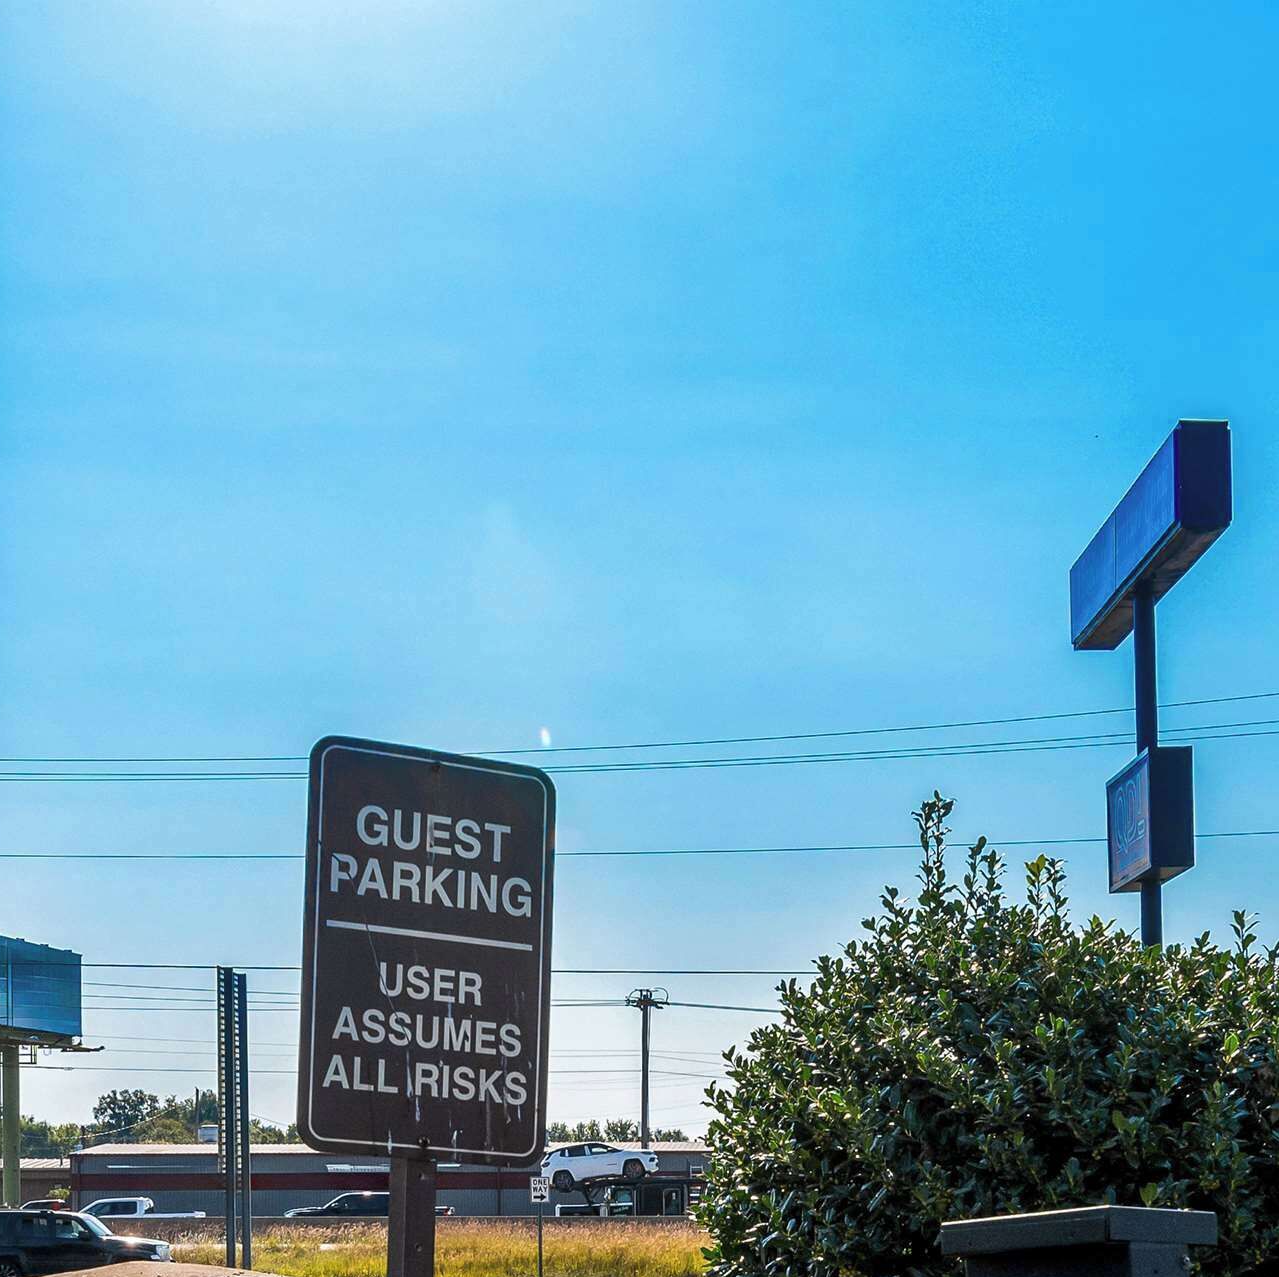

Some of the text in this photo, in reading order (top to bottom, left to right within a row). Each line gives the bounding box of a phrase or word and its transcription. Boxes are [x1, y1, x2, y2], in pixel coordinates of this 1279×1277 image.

[356, 805, 511, 863] GUEST
[330, 853, 532, 918] PARKING
[380, 962, 482, 1006] USER
[332, 1006, 521, 1057] ASSUMES
[322, 1054, 527, 1106] ALL RISKS
[532, 1178, 548, 1186] ONE
